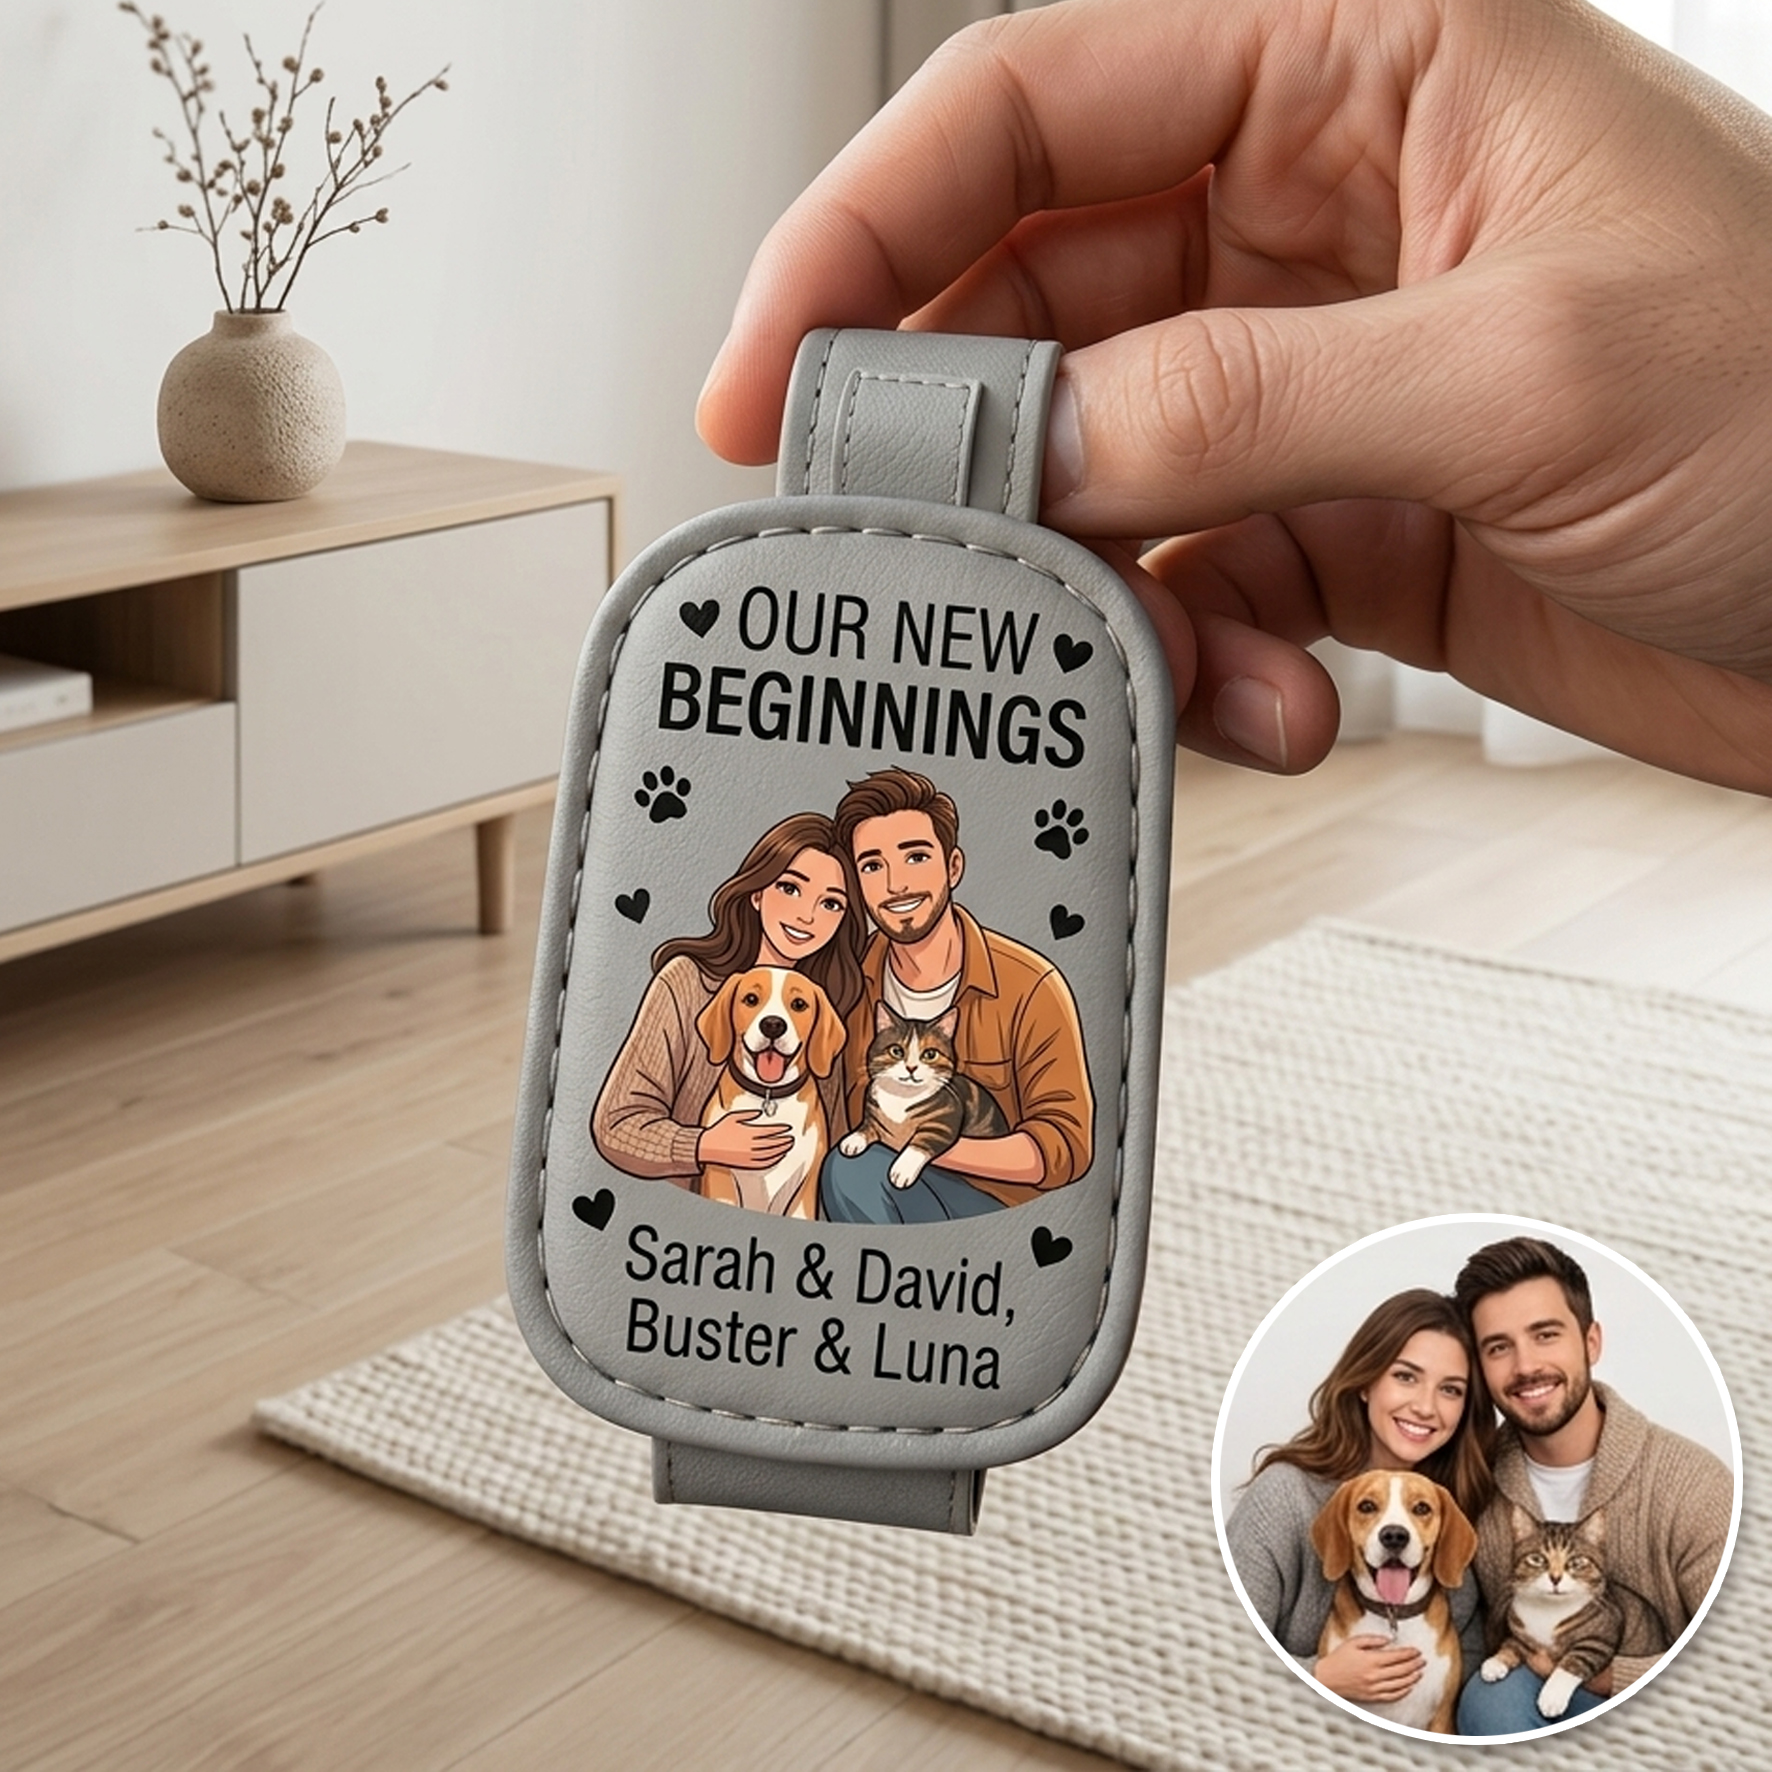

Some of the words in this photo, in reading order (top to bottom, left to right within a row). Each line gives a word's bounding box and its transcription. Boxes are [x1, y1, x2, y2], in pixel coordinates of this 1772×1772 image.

[738, 585, 870, 660] OUR
[892, 600, 1041, 676] NEW
[658, 661, 1087, 769] BEGINNINGS
[625, 1224, 776, 1294] Sarah
[795, 1242, 834, 1301] &
[856, 1247, 1016, 1328] David,
[626, 1297, 798, 1368] Buster
[814, 1317, 852, 1376] &
[873, 1322, 1001, 1391] Luna
